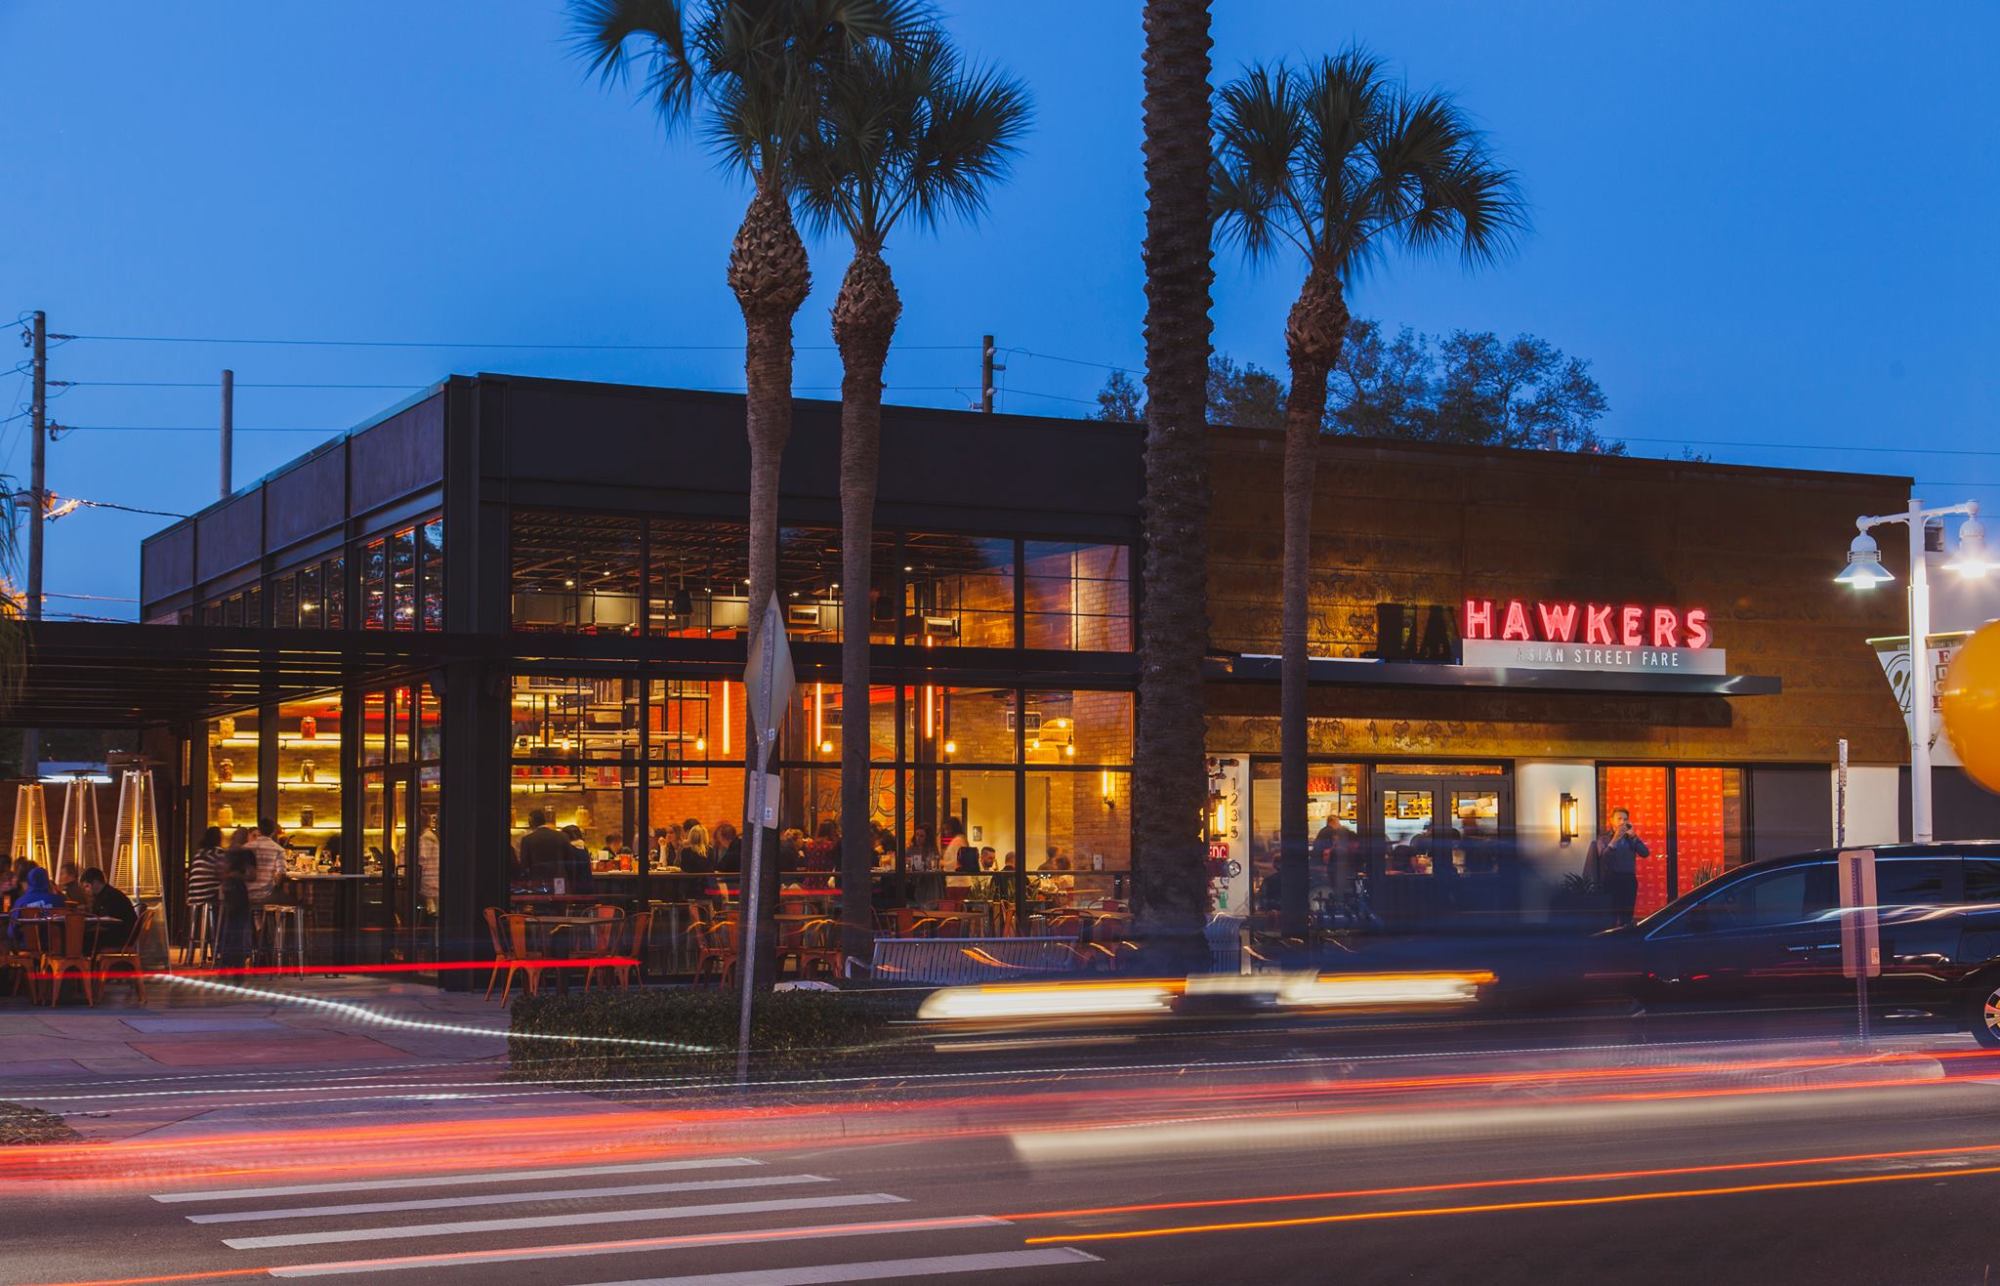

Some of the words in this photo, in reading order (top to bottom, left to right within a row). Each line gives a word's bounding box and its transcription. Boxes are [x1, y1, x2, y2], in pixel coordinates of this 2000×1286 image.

[1465, 599, 1708, 649] HAWKERS
[1517, 647, 1564, 663] ASIAN
[1574, 649, 1632, 665] STREET
[1642, 651, 1679, 667] FARE
[1209, 846, 1227, 859] DC
